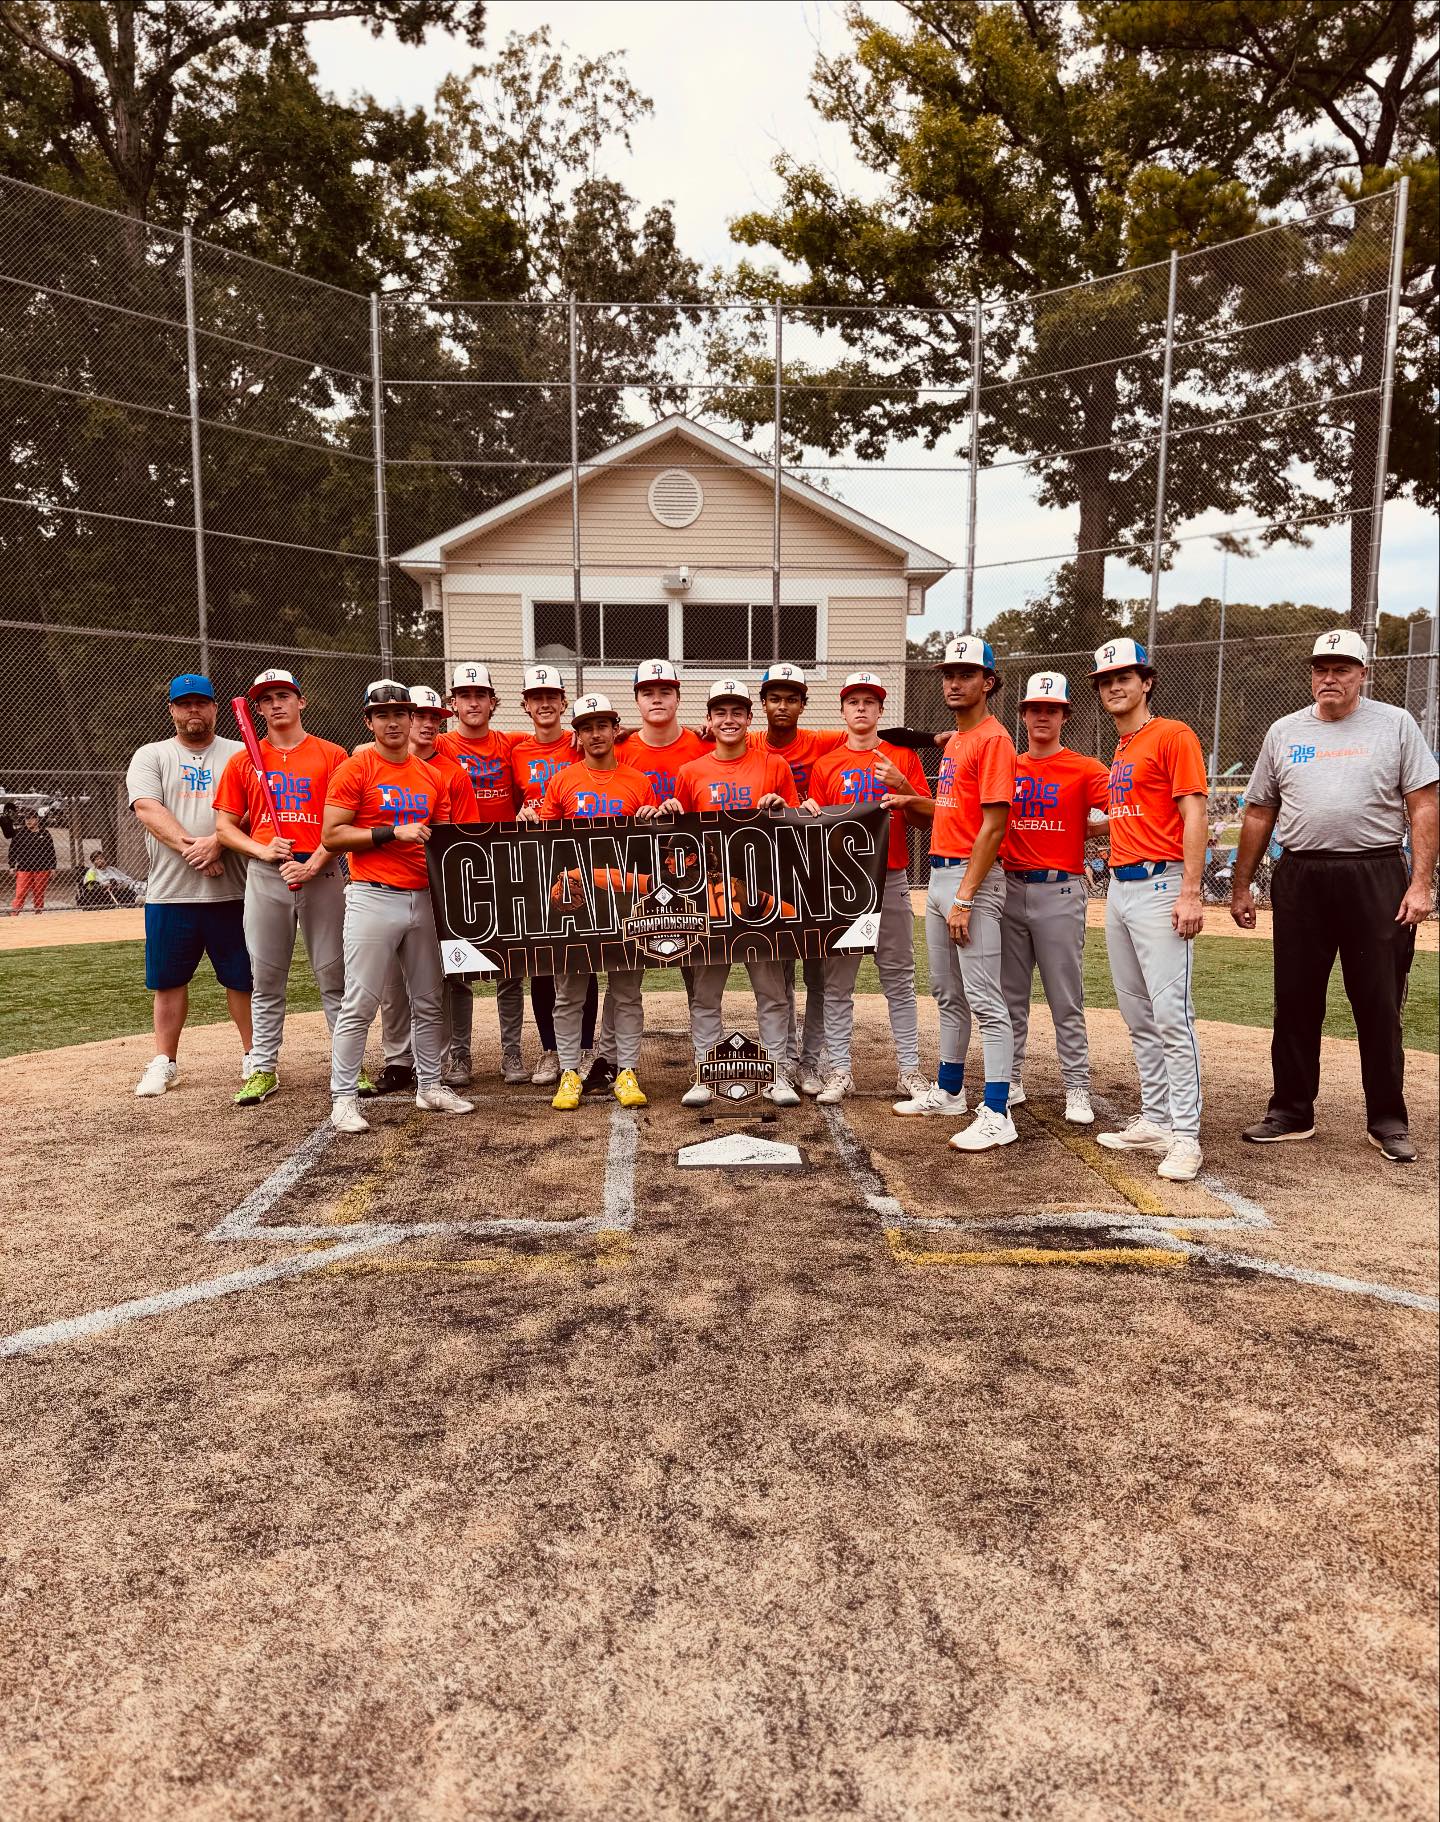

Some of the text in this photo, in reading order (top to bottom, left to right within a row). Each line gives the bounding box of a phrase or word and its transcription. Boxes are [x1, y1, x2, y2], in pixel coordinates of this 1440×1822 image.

[1288, 744, 1316, 758] Dig
[179, 764, 213, 785] Dig
[266, 770, 312, 803] Dig
[708, 781, 752, 808] Dig
[1012, 776, 1061, 808] Dig
[377, 783, 430, 820] Dig
[575, 791, 624, 817] Dig
[1010, 819, 1066, 832] ASEBALL
[442, 820, 878, 945] CHAMPIONS
[656, 906, 674, 914] FALL
[627, 915, 704, 936] CHAMPIONSHIPS
[728, 1050, 746, 1059] FALL
[701, 1061, 773, 1081] CHAMPIONS
